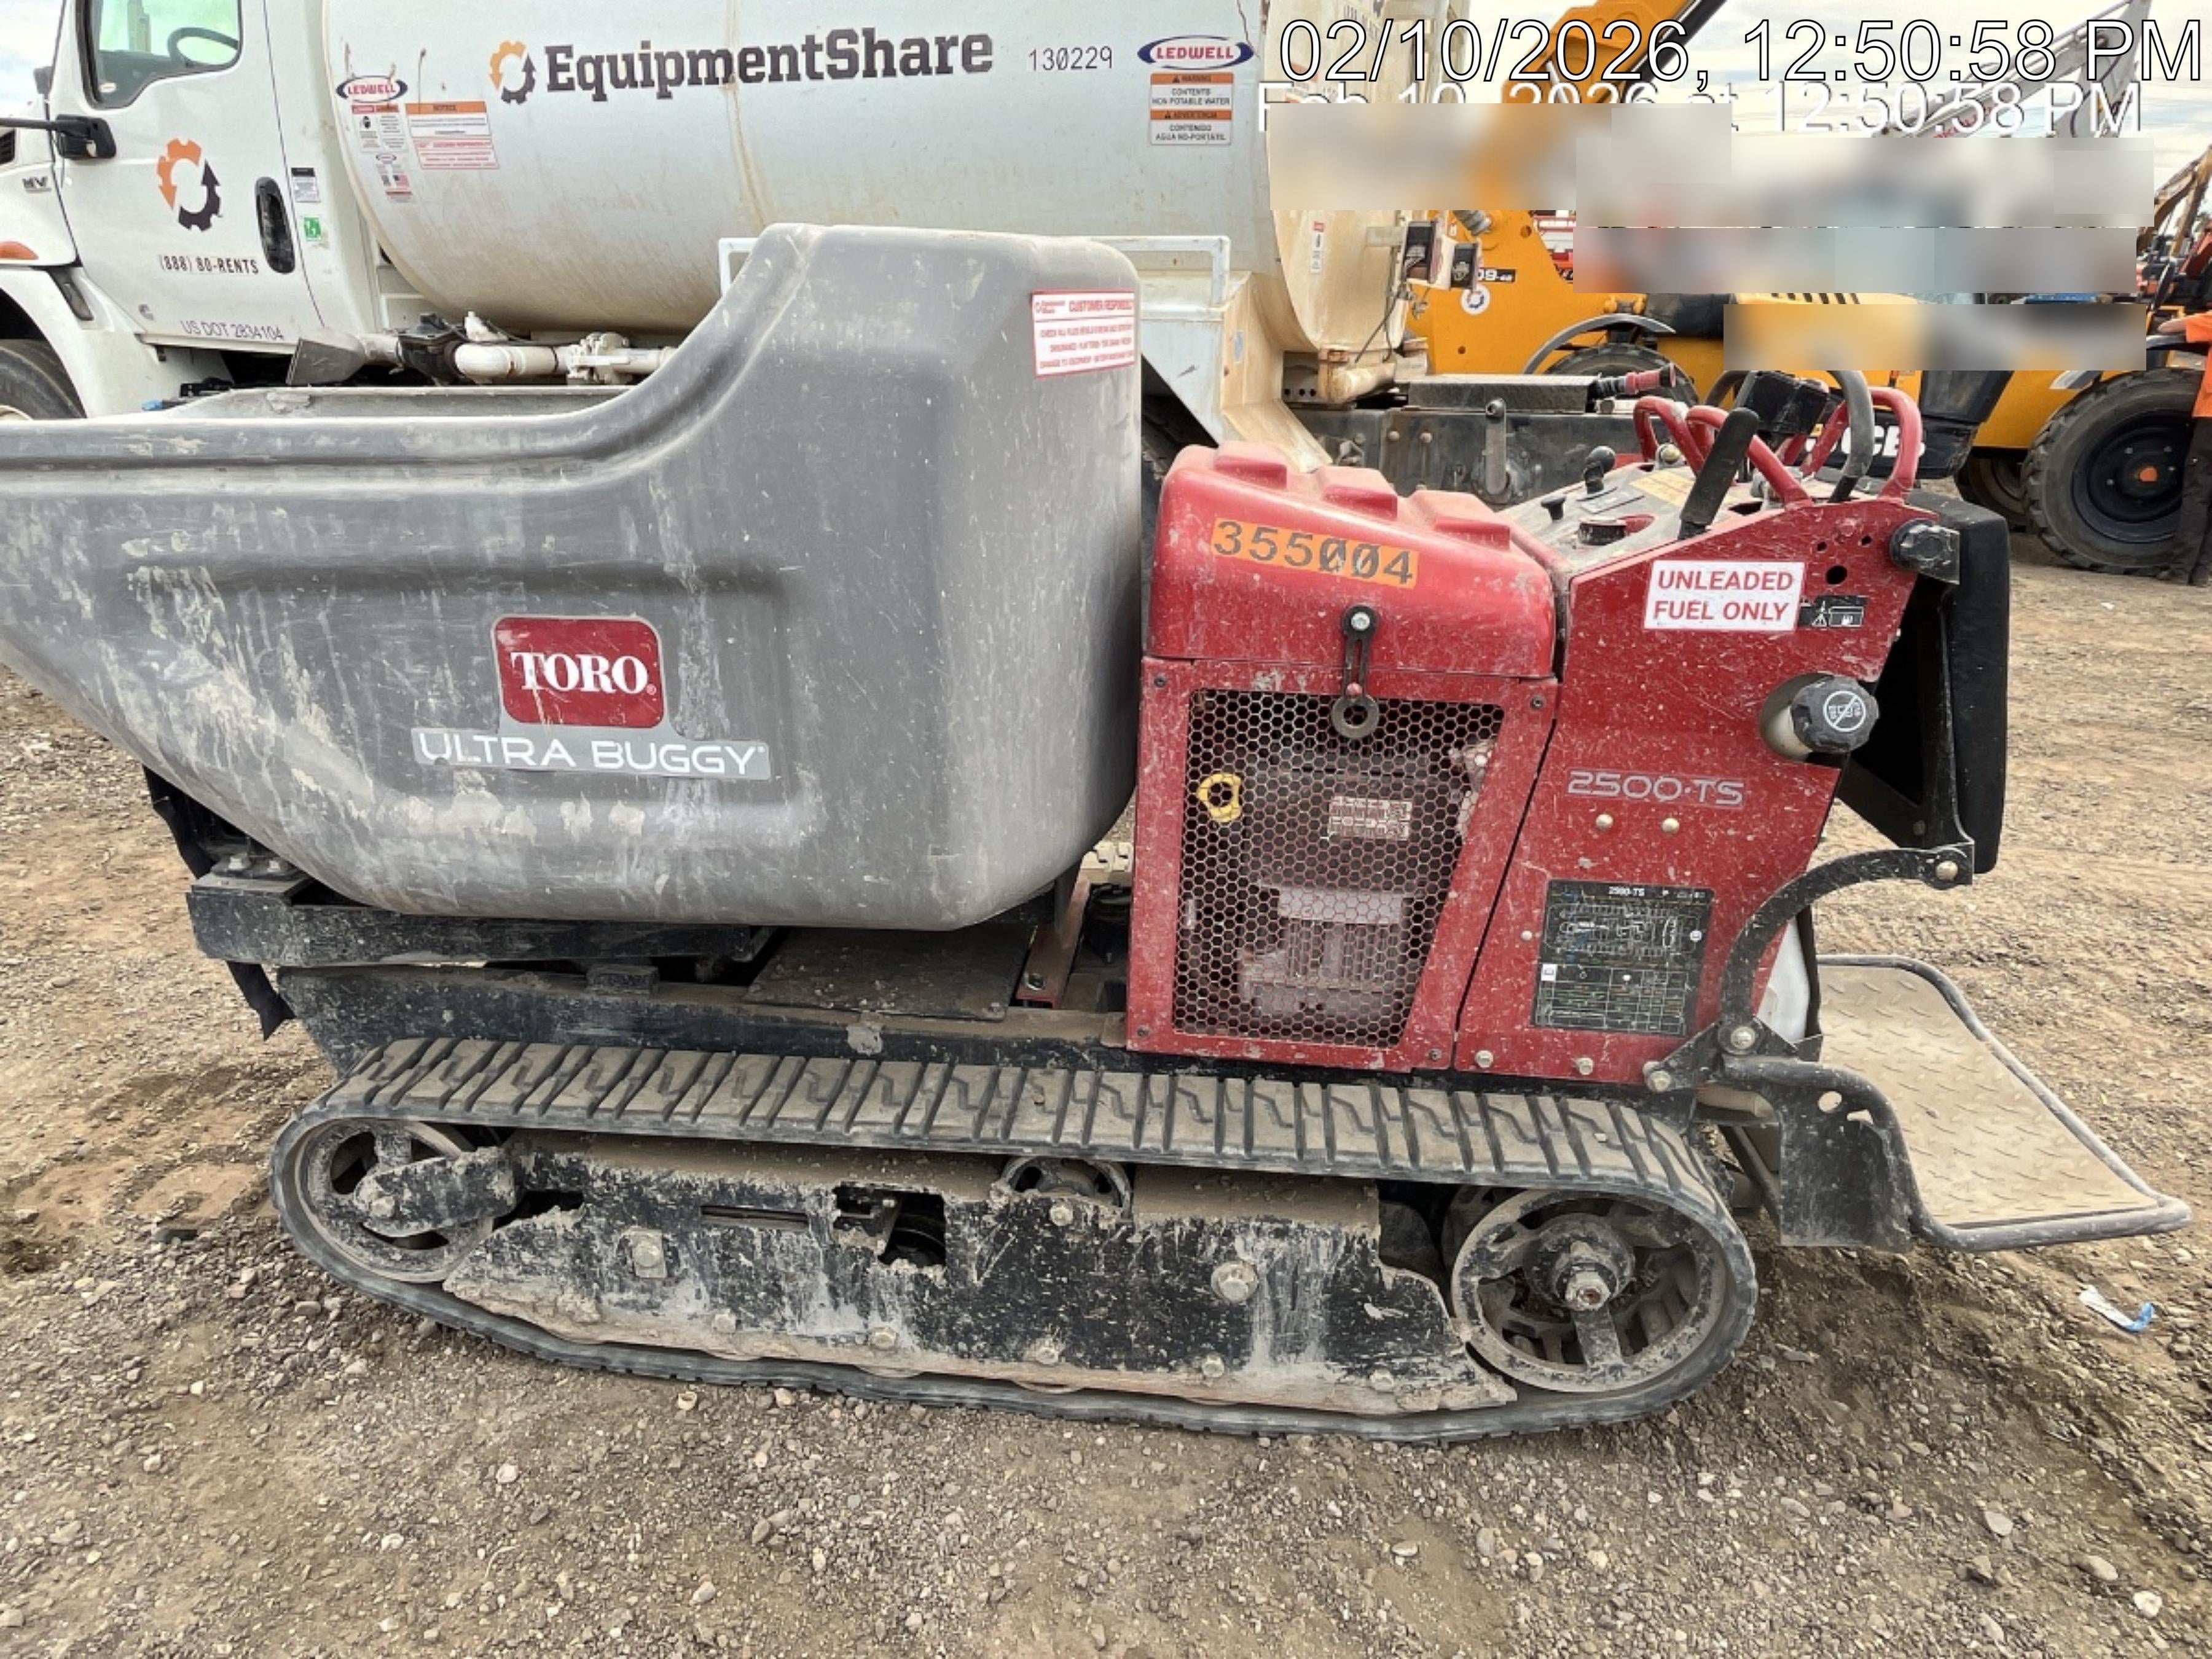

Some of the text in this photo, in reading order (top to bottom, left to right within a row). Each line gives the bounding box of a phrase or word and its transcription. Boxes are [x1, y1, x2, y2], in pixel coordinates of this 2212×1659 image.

[544, 27, 994, 102] EquipmentShare
[1028, 45, 1113, 71] 130229
[1156, 46, 1234, 60] LEDWELL
[348, 84, 396, 95] LEDWELL
[159, 254, 259, 274] (888) 80-RENTS
[1213, 520, 1413, 584] 355004
[1658, 570, 1793, 590] UNLEADED
[1654, 600, 1789, 621] FUEL ONLY
[511, 652, 648, 694] TORO
[418, 732, 758, 774] ULTRA BUGGY
